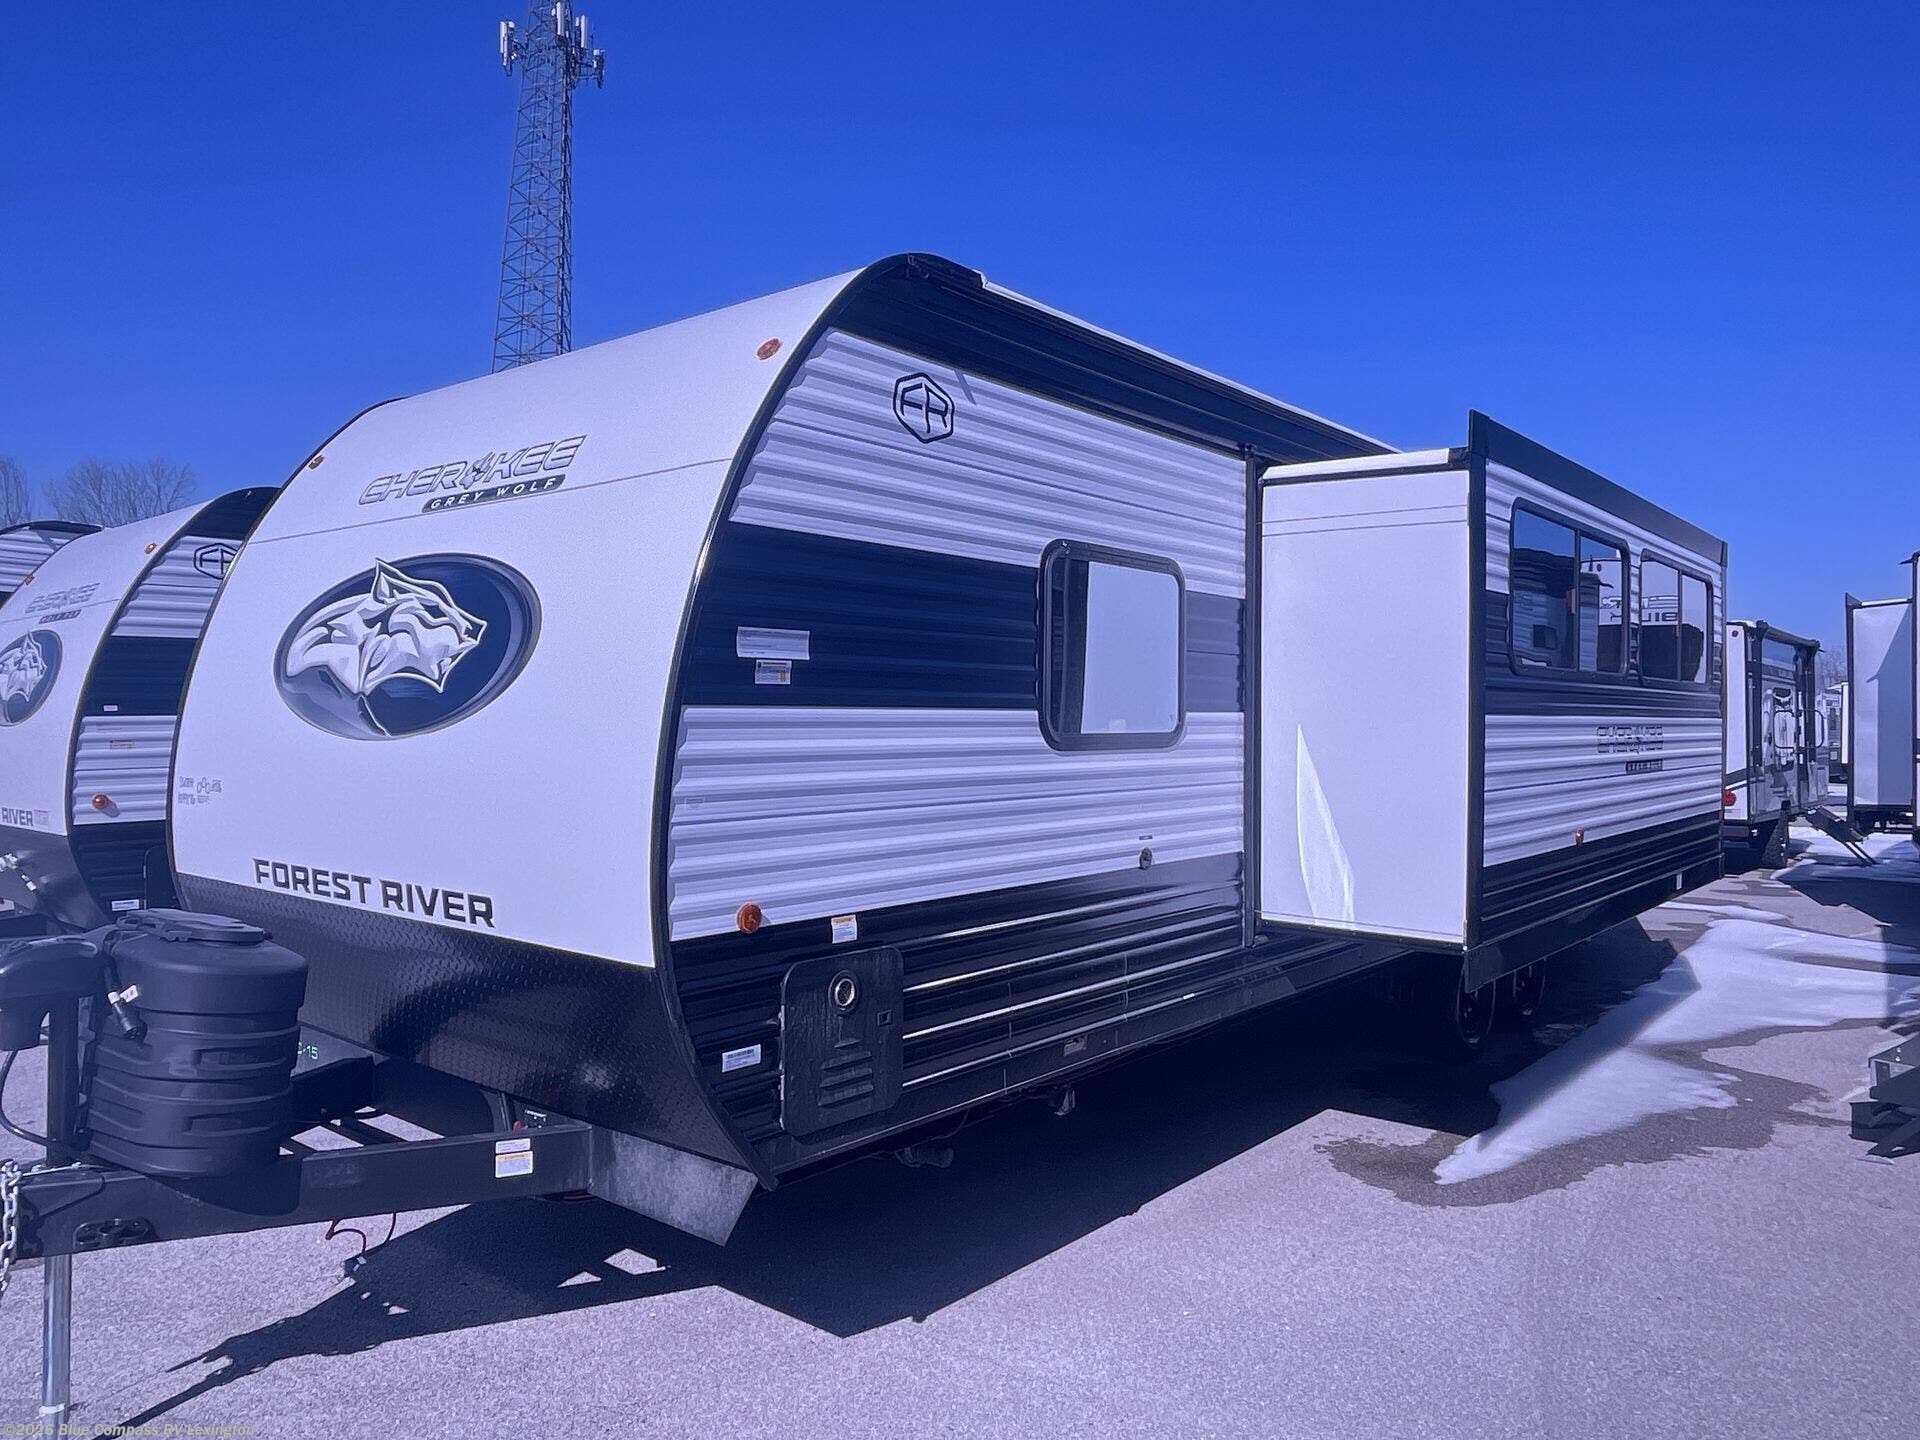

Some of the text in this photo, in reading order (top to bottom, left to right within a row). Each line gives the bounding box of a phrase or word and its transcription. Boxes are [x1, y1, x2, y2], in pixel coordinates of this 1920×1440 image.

[359, 434, 588, 505] CHEROKEE
[430, 477, 557, 509] GREY WOLF
[1, 807, 34, 827] RIVER
[253, 858, 495, 929] FOREST RIVER
